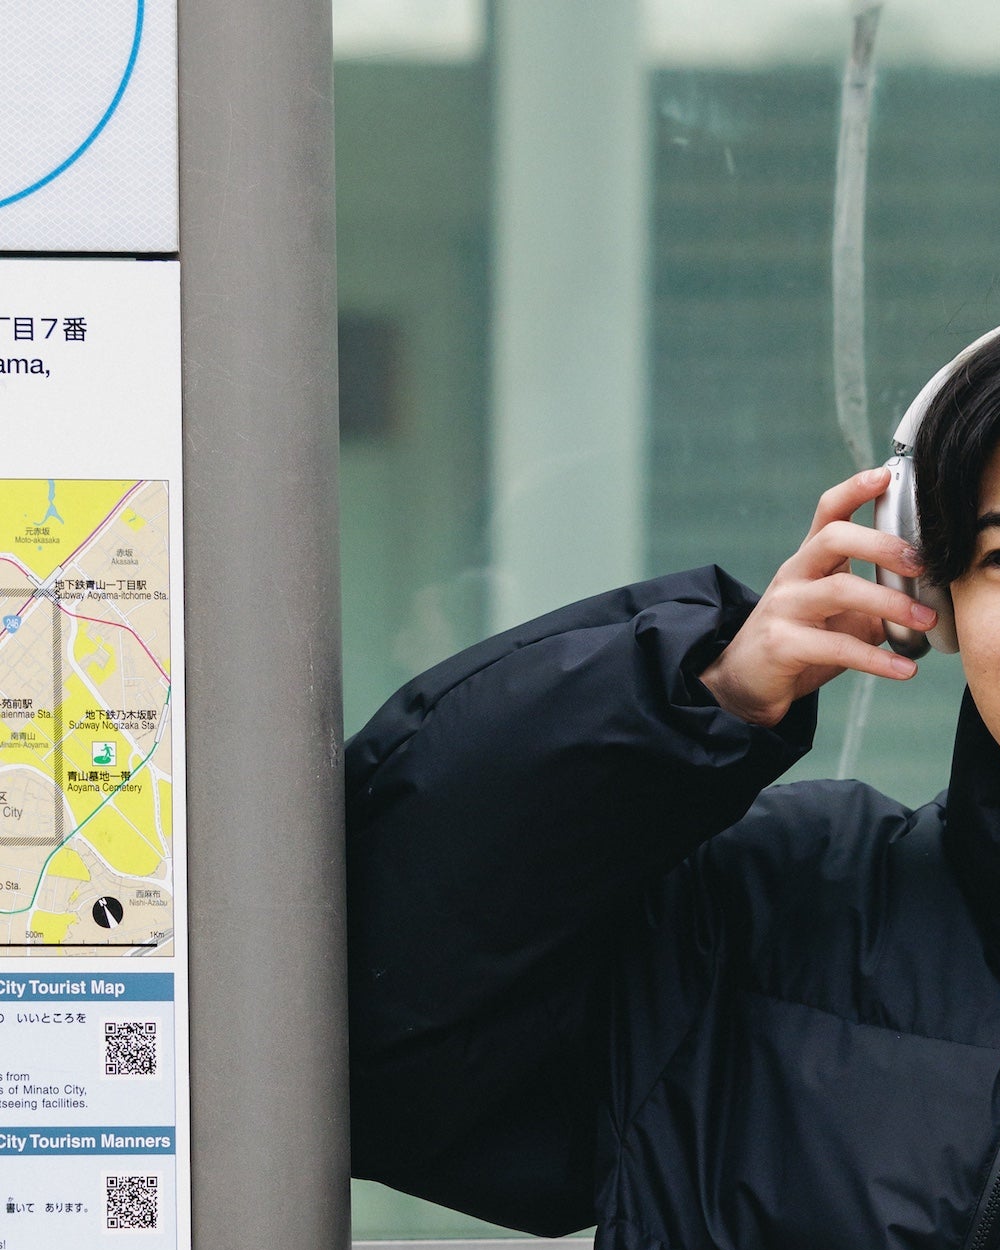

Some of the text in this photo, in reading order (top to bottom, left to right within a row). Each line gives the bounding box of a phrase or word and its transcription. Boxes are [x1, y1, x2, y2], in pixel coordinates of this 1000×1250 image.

[15, 536, 60, 544] Moto-akasaka
[55, 591, 169, 601] Subway Aoyama-itchome Sta.
[0, 699, 33, 709] 苑前駅
[69, 721, 157, 731] Subway Nogizaka Sta.
[67, 783, 142, 793] Aoyama Cemetery
[3, 806, 23, 819] City
[5, 881, 21, 890] Sta.
[0, 980, 125, 998] City Tourist Map
[17, 1013, 86, 1023] いいところを
[6, 1072, 30, 1081] from
[8, 1085, 19, 1095] of
[23, 1085, 59, 1094] Minato
[64, 1084, 86, 1097] City,
[42, 1098, 88, 1108] facilities.
[0, 1134, 171, 1152] City Tourism Manners
